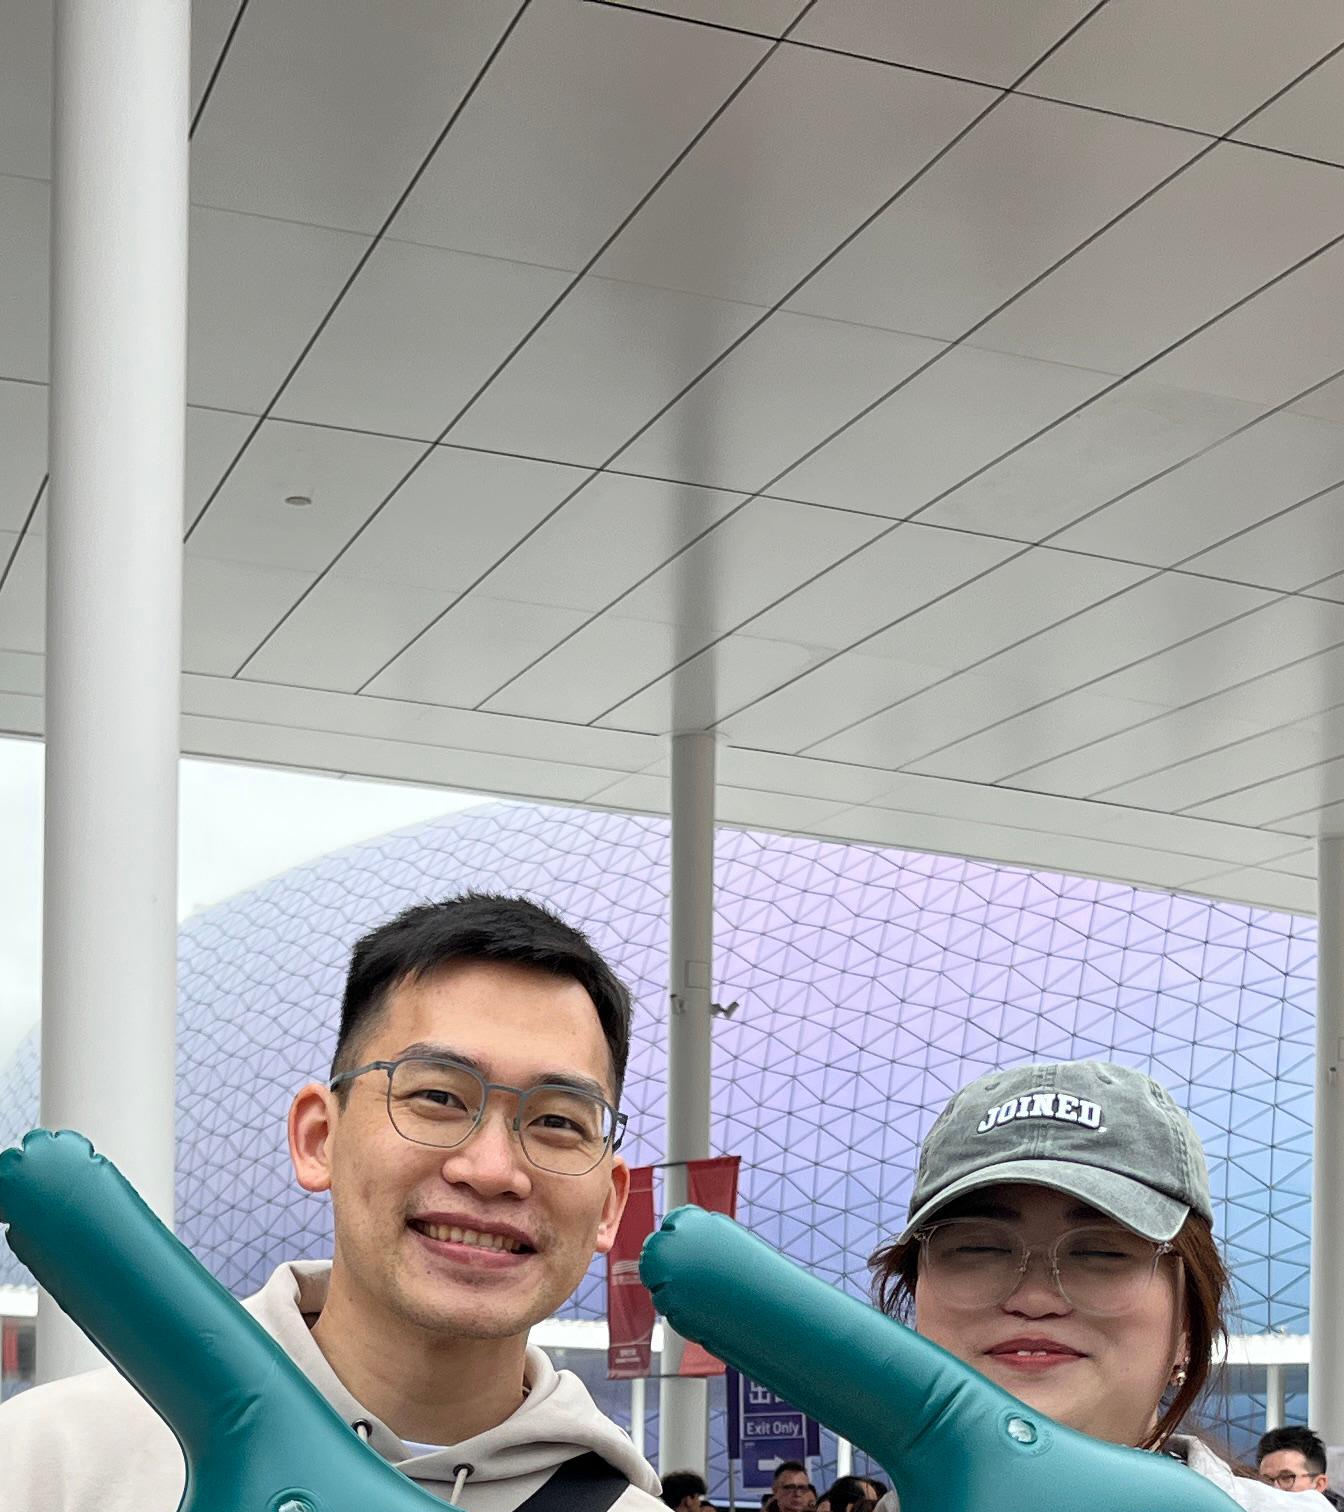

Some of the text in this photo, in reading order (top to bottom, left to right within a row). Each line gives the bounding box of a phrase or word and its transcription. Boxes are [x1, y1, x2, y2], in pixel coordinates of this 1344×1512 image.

[977, 1093, 1102, 1134] JOINED
[746, 1421, 799, 1437] Exit Only
